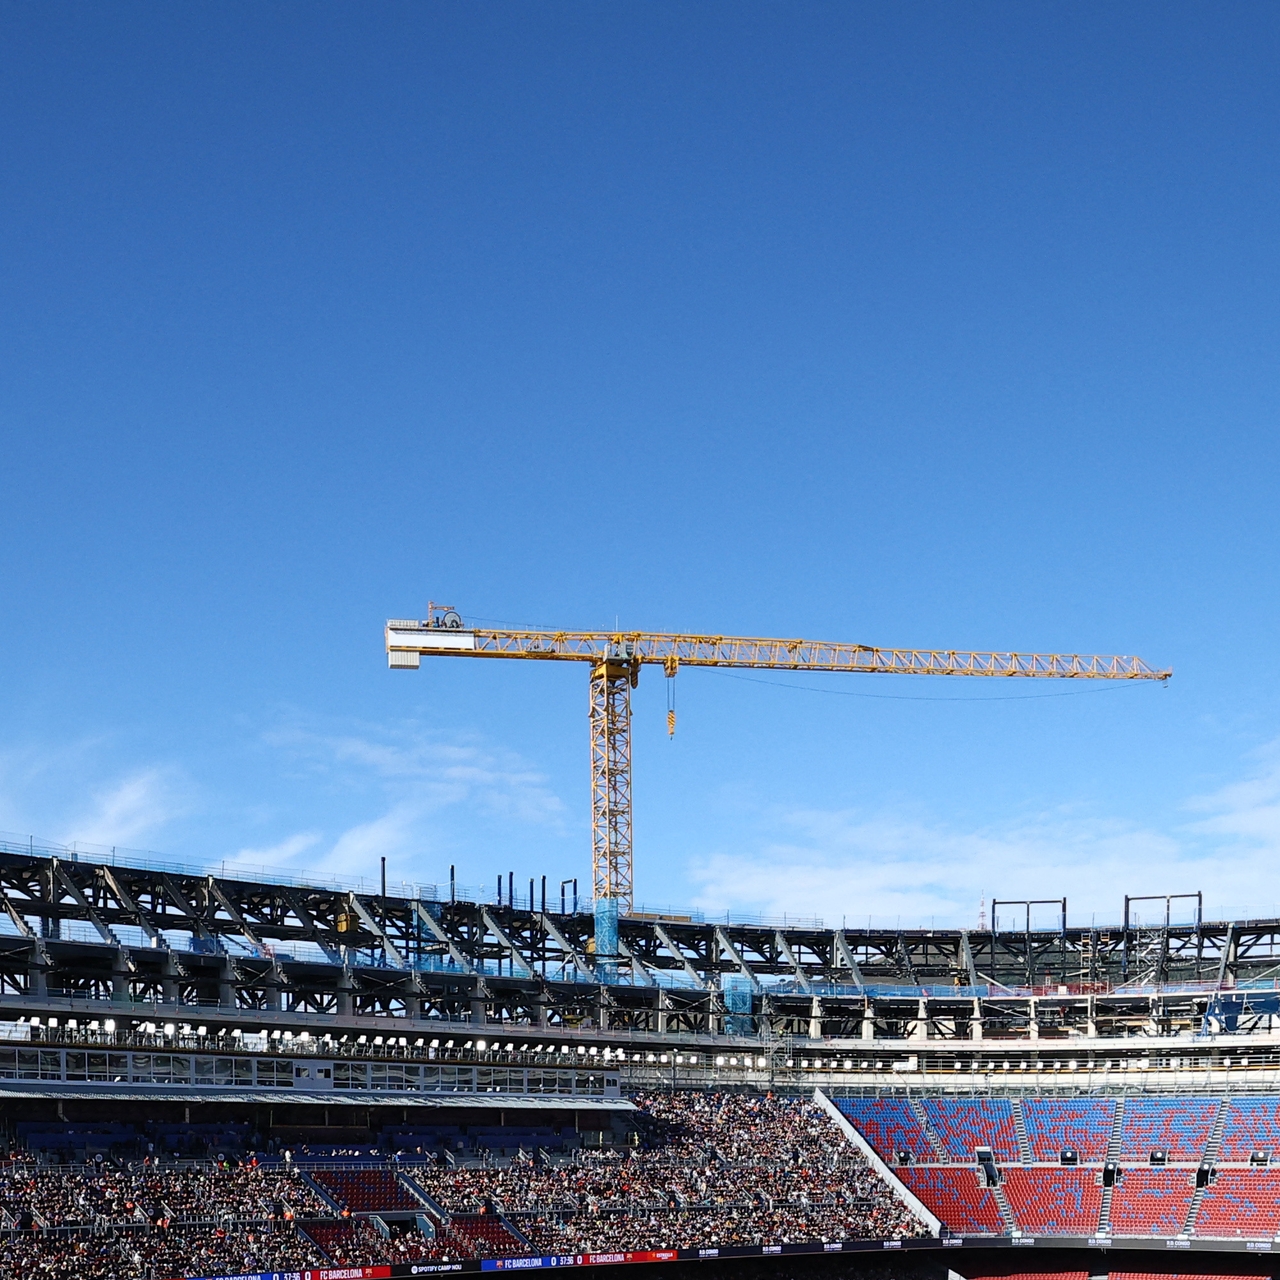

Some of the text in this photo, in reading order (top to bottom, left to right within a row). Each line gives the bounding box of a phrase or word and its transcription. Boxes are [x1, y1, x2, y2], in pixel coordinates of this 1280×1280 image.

[505, 1260, 512, 1268] FC
[512, 1258, 542, 1268] BARCELONA
[551, 1257, 557, 1266] 0
[577, 1255, 582, 1264] 0
[589, 1255, 596, 1263] FC
[596, 1254, 625, 1263] BARCELONA
[320, 1271, 328, 1280] FC
[328, 1268, 363, 1279] BARCELONA
